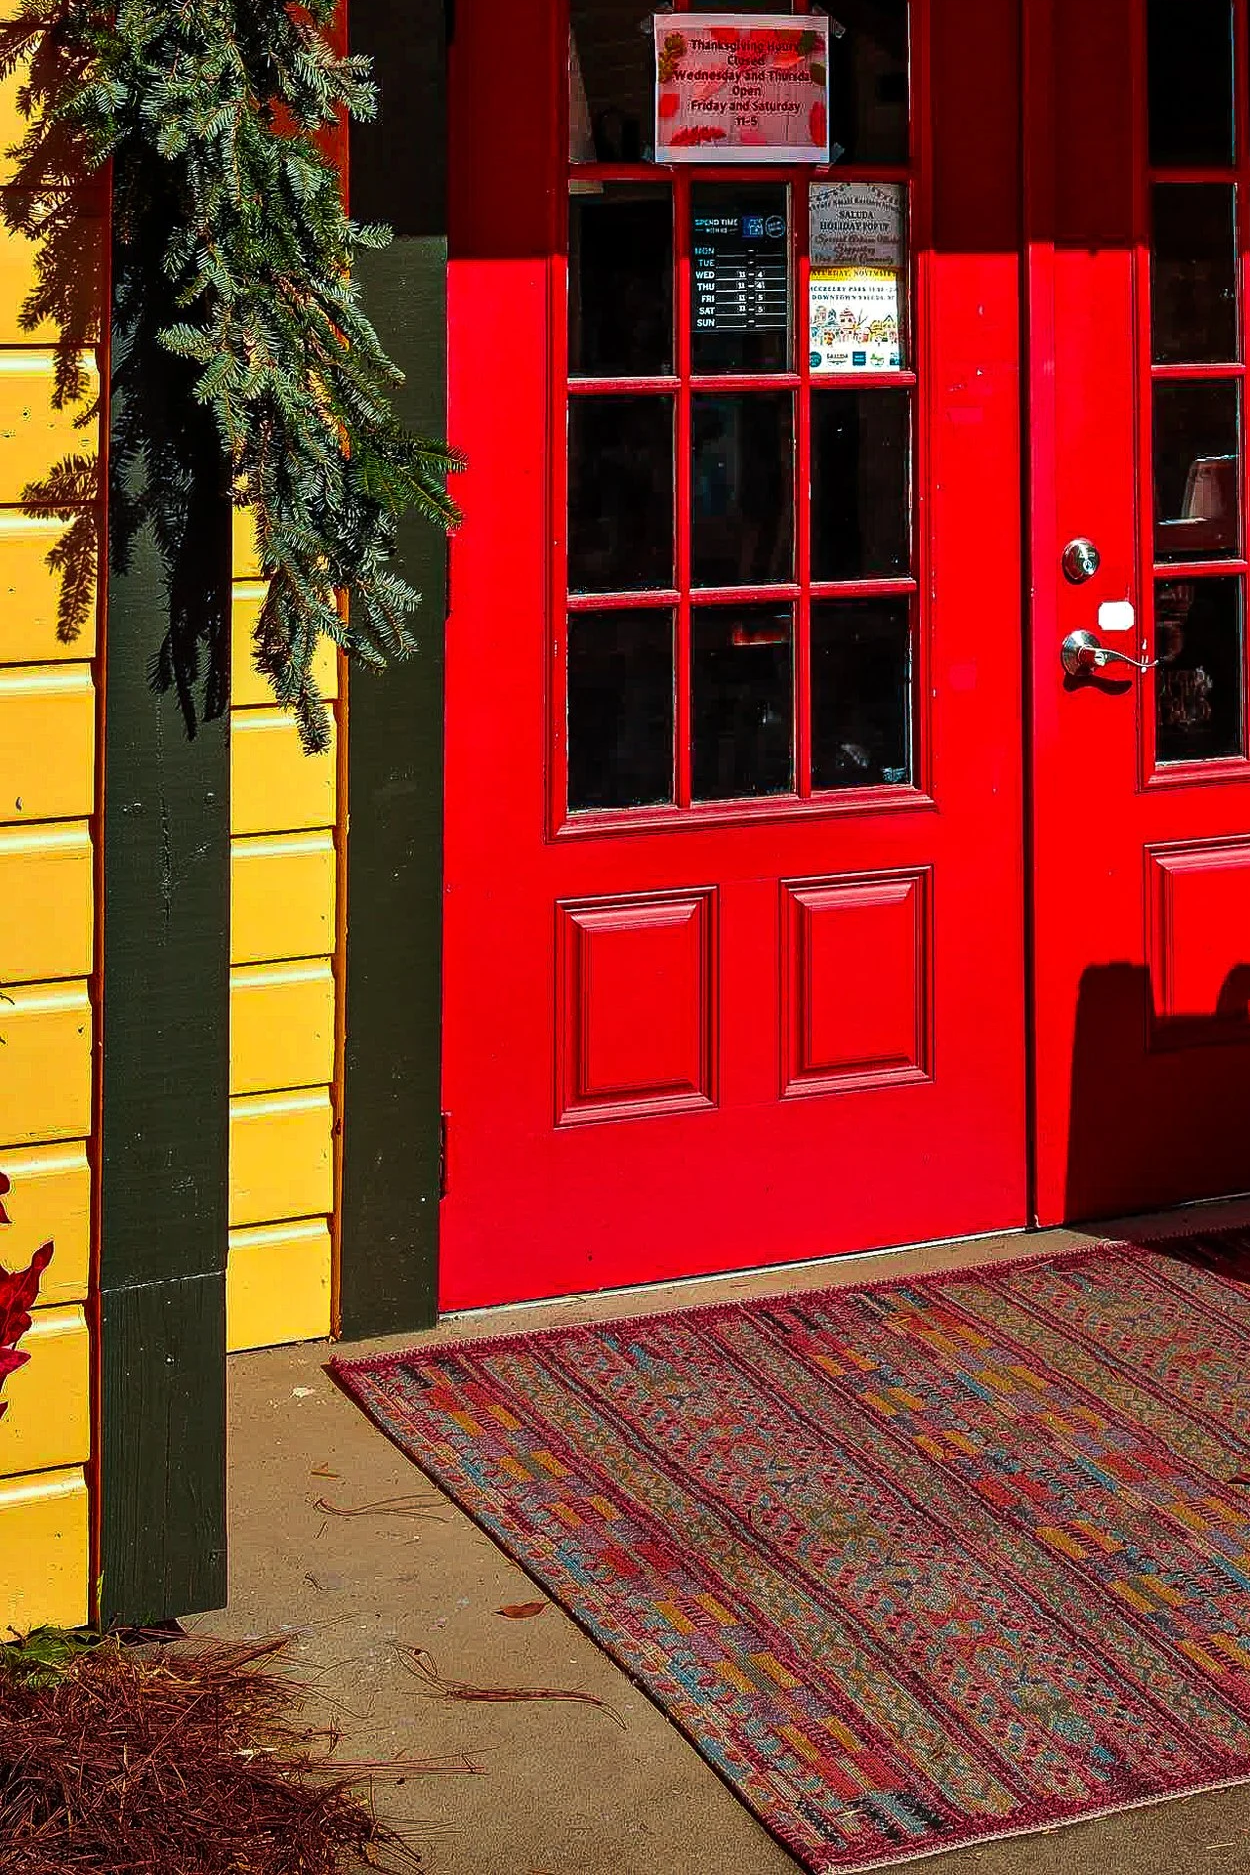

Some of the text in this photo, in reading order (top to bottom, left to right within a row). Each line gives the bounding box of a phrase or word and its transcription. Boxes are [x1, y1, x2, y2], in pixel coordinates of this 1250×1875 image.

[691, 39, 764, 53] Thanksgiving
[727, 54, 765, 66] Closed
[674, 70, 740, 85] Wednesday
[745, 70, 765, 81] and
[732, 86, 761, 97] Open
[691, 100, 801, 114] Friday and Saturday
[838, 211, 874, 219] SALUDA
[820, 222, 861, 231] HOLIDAY
[698, 259, 715, 267] TUE
[695, 271, 715, 279] WED
[697, 283, 715, 291] THU
[701, 295, 715, 303] FRI
[699, 307, 715, 315] SAT
[697, 319, 715, 327] SUN
